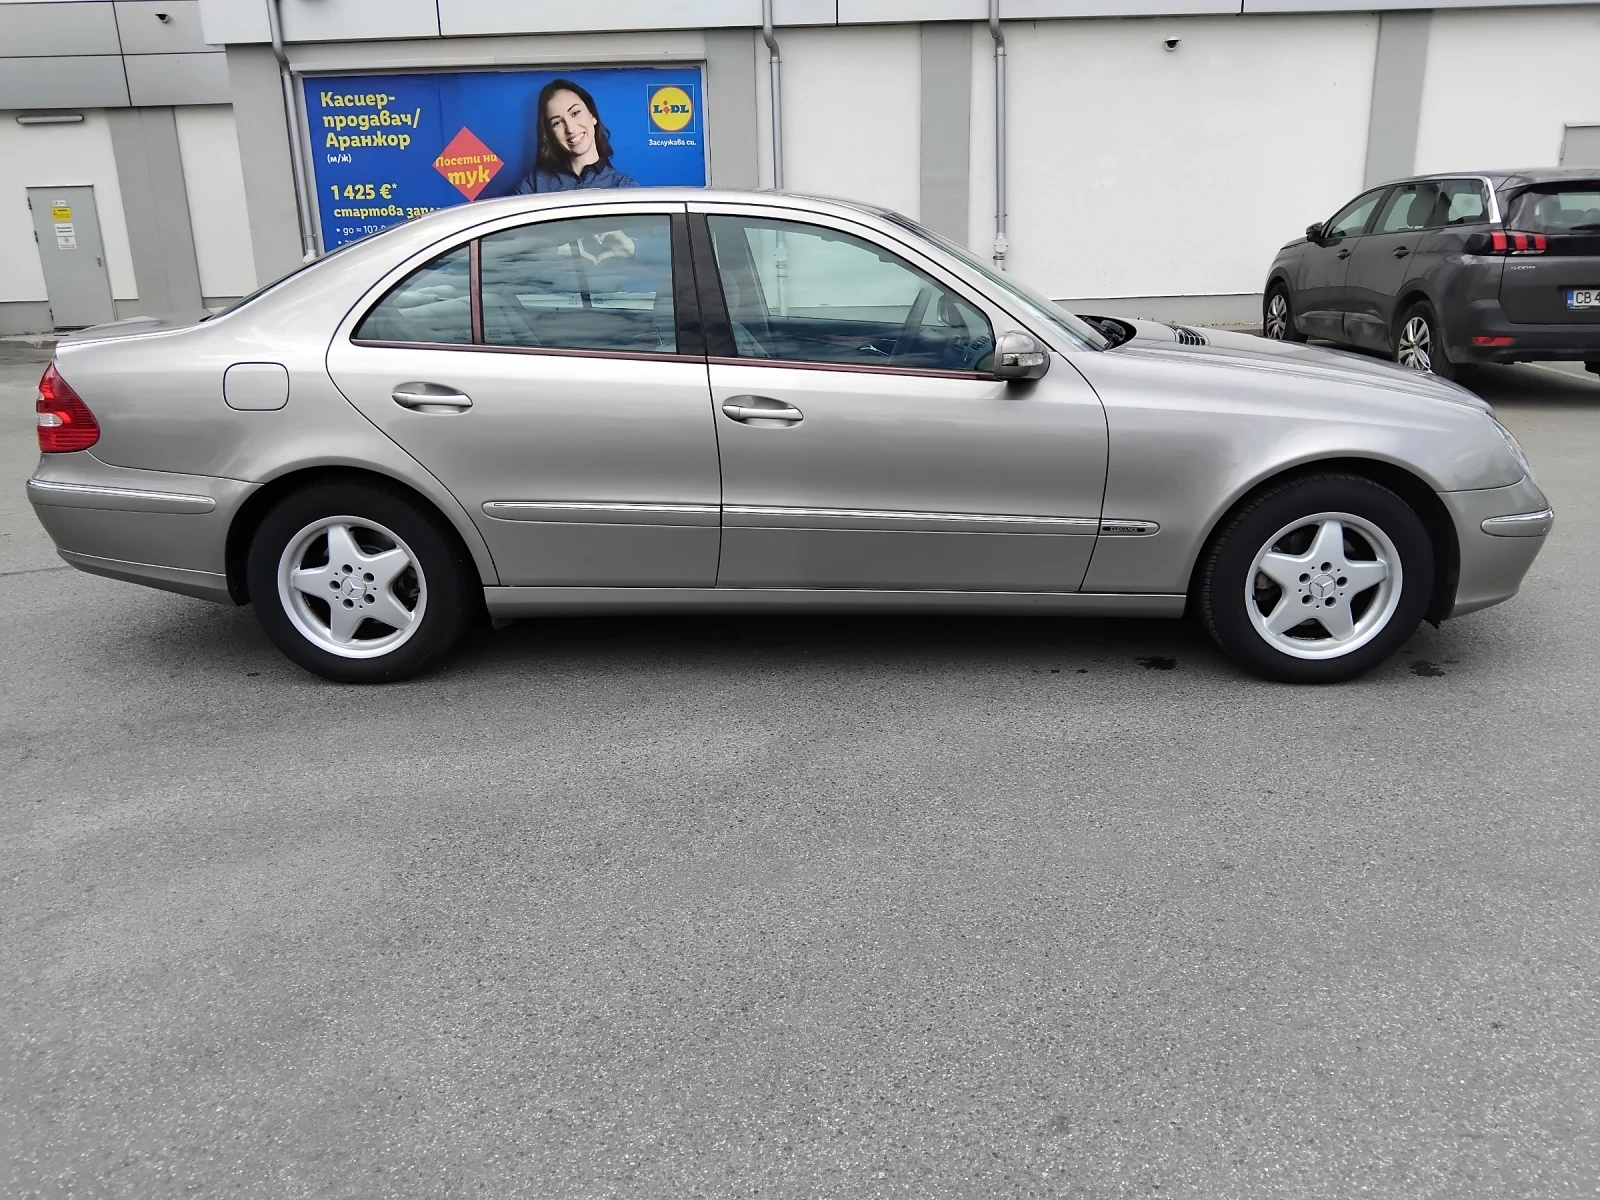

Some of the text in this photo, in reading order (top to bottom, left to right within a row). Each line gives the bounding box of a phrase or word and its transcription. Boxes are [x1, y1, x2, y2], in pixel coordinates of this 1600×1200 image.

[320, 91, 396, 109] Касиер-
[322, 108, 421, 131] продавач/
[325, 130, 411, 151] Аранжор
[648, 138, 697, 147] Заслужава си.
[327, 153, 352, 164] (м/ж)
[435, 153, 498, 168] Посети ни
[447, 164, 491, 189] тук
[333, 205, 442, 220] стартова зап
[342, 227, 355, 236] до
[1576, 291, 1592, 304] CB
